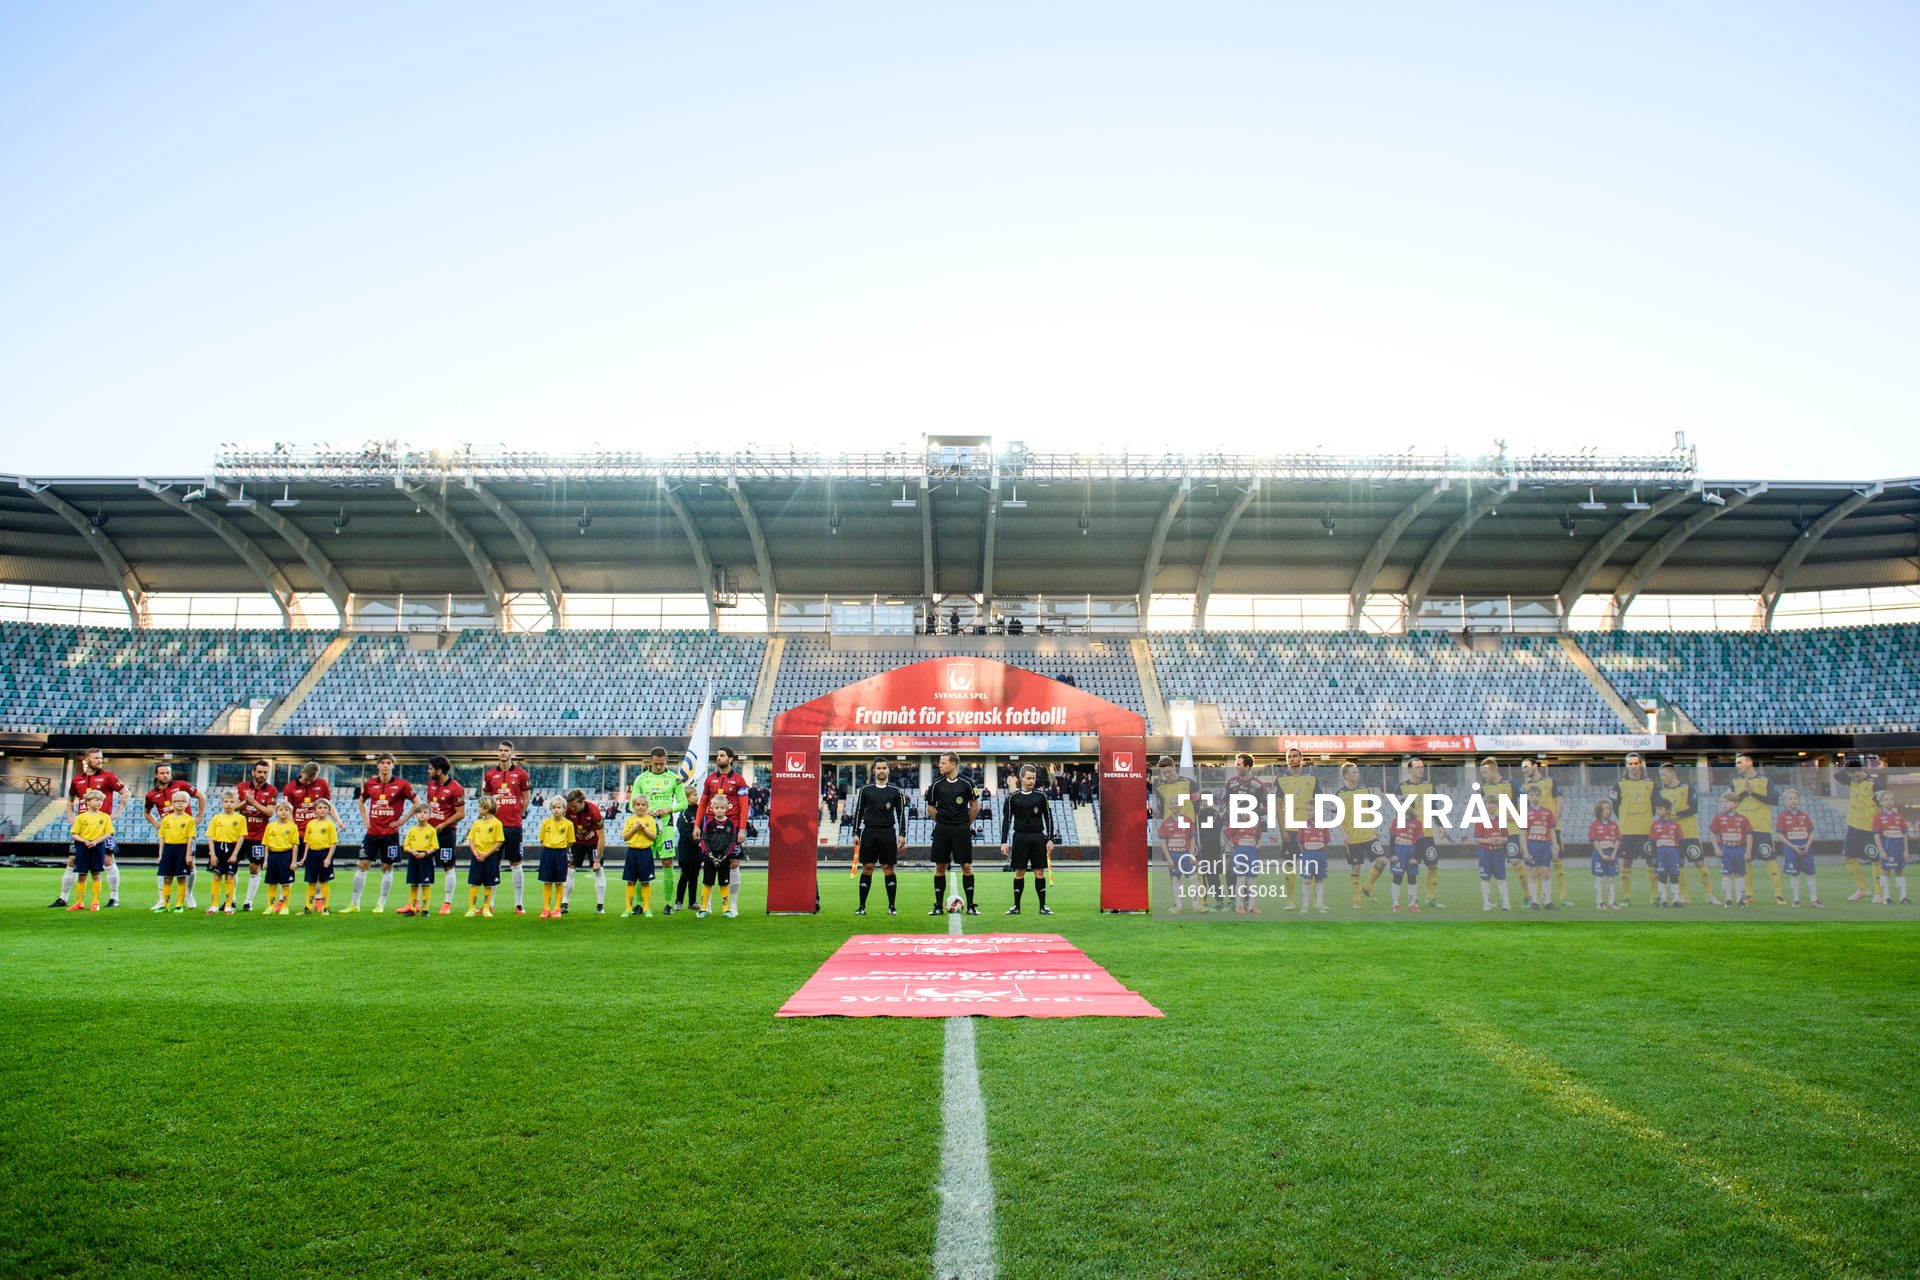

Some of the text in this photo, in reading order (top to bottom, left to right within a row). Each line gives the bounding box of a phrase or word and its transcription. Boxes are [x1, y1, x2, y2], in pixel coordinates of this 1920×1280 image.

[934, 692, 989, 700] SVENSKA SPEL
[855, 705, 1068, 725] Framåt för svensk fotboll!
